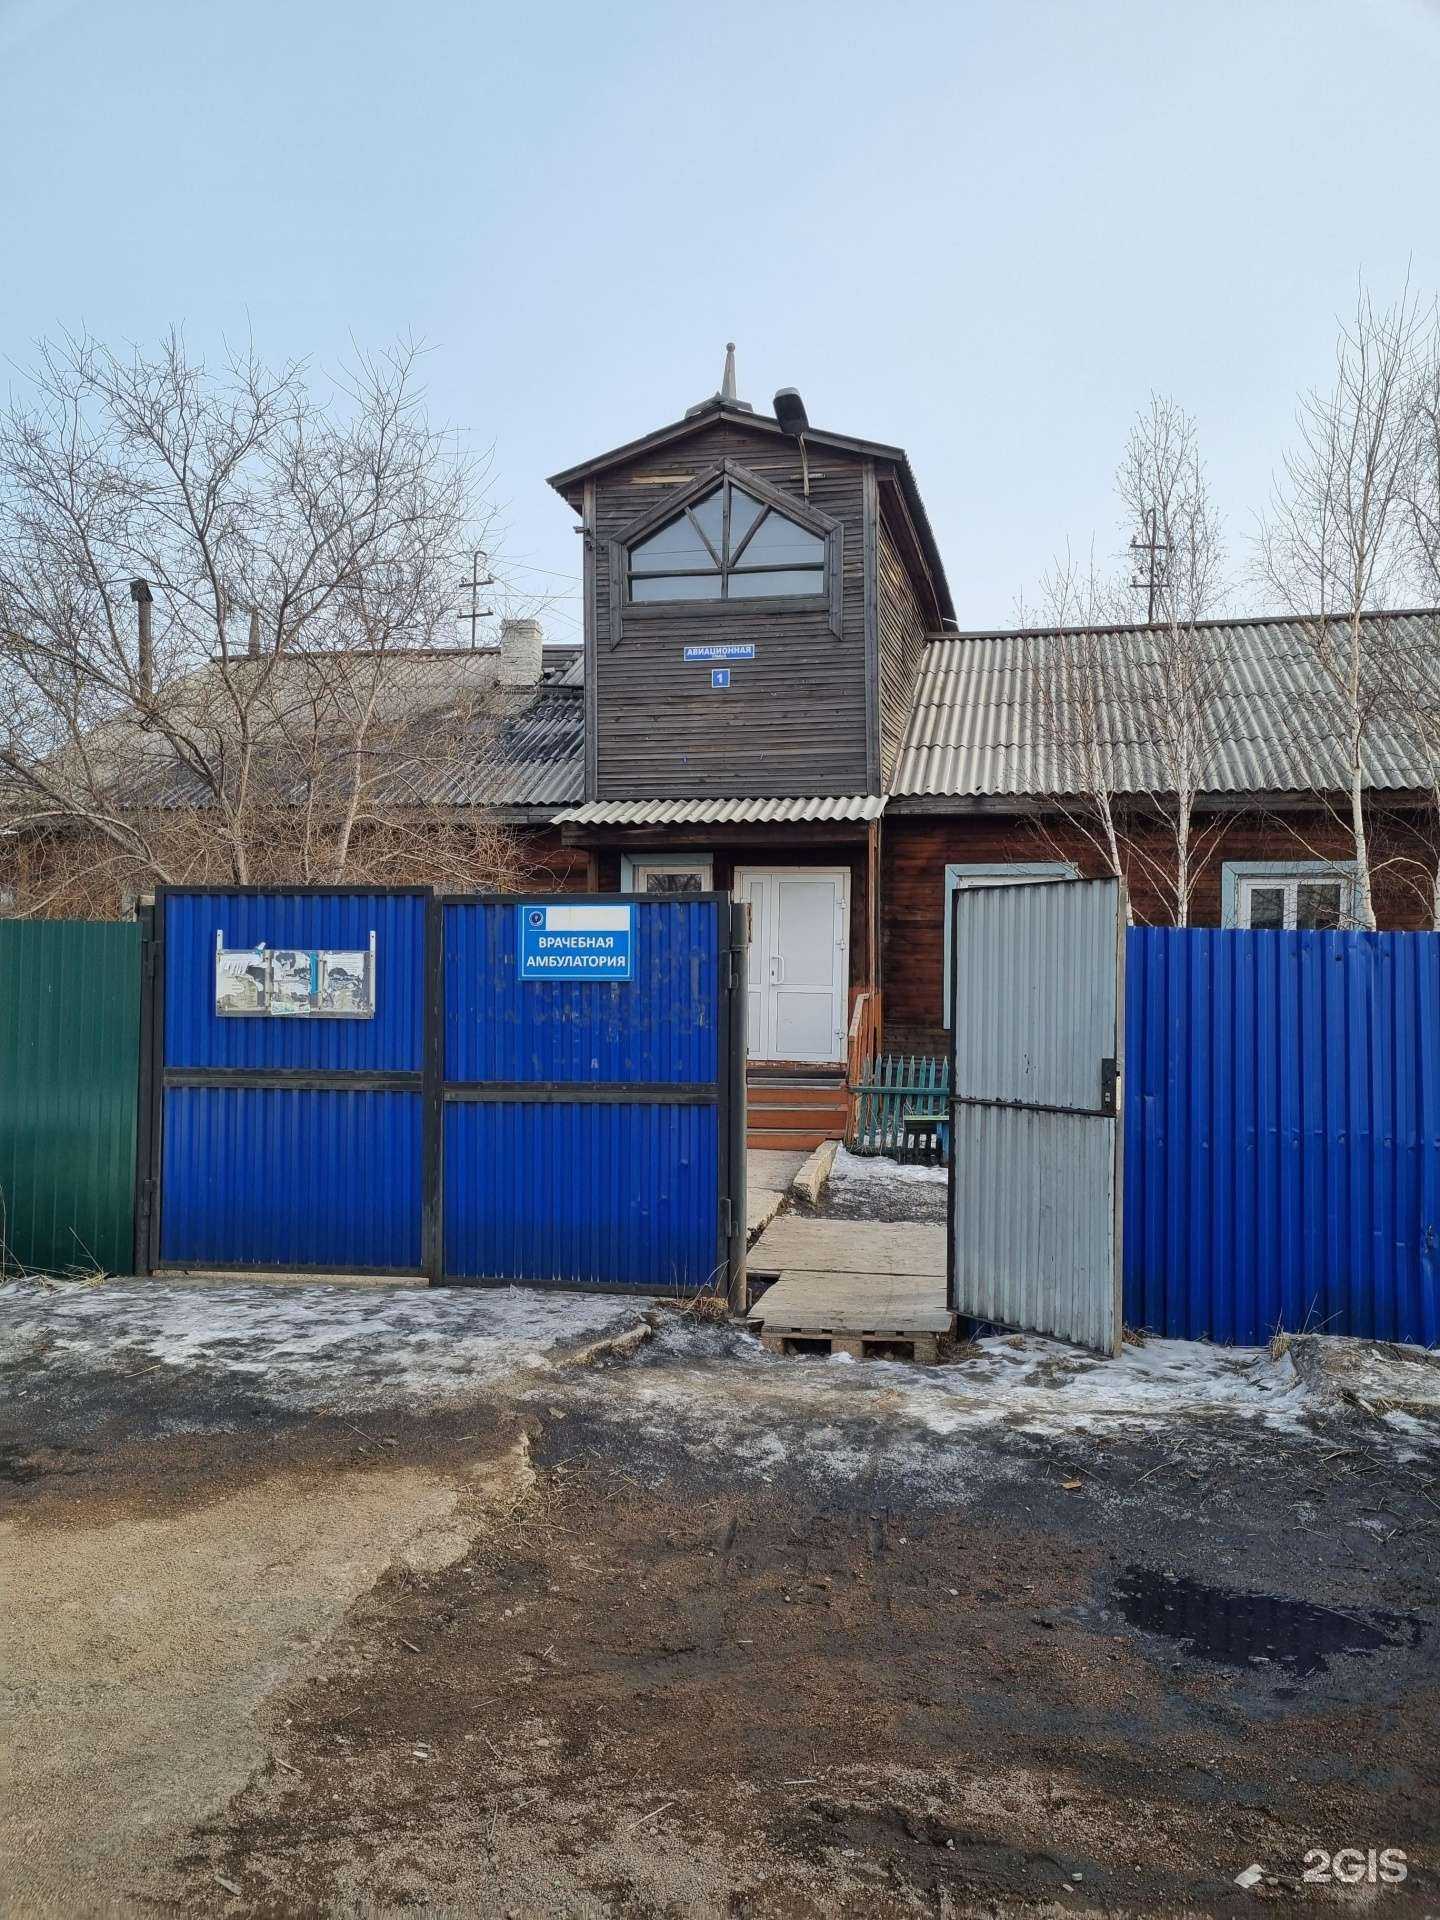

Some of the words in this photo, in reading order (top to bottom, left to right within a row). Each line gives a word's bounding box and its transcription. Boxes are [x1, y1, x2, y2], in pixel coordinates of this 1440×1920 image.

[686, 646, 752, 656] АВИАЦИОННАЯ
[716, 673, 723, 683] 1
[538, 936, 614, 948] ВРАЧЕБНАЯ
[526, 955, 626, 967] АМБУЛАТОРИЯ
